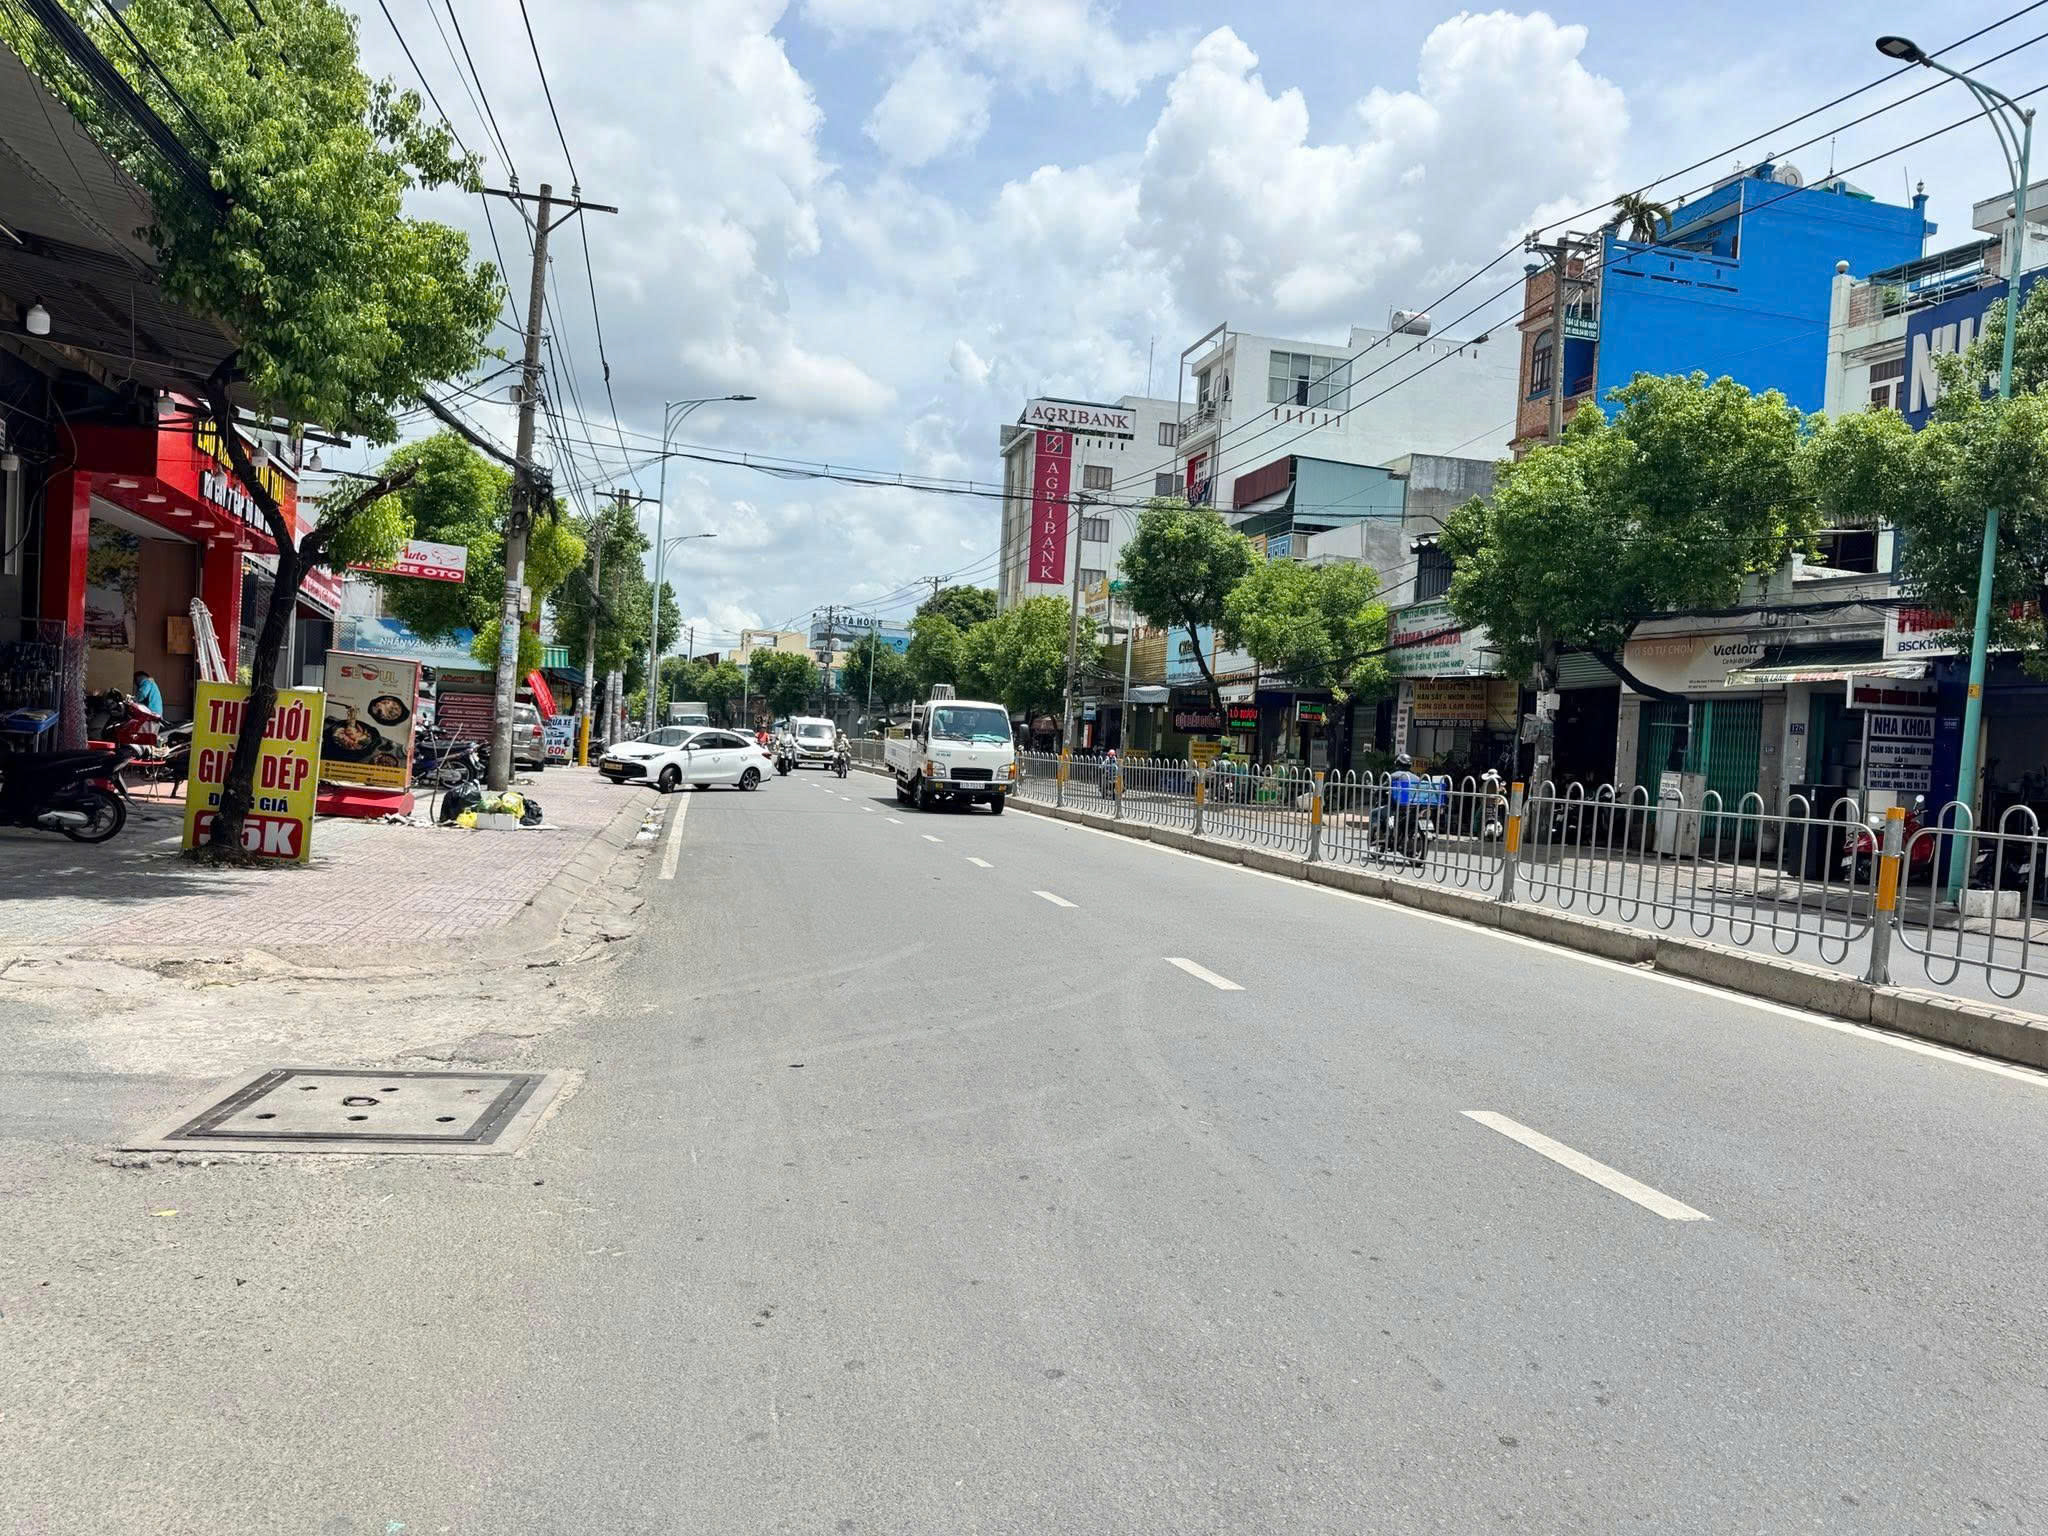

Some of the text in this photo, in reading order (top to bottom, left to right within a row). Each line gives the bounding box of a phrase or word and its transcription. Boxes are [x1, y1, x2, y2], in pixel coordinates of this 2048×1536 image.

[1032, 406, 1129, 429] AGRIBANK
[1040, 462, 1059, 579] AGRIBANK
[423, 566, 462, 581] OTO
[1668, 642, 1694, 657] CHỌN
[1713, 643, 1758, 657] Vietlott
[563, 718, 573, 728] XE
[1873, 716, 1899, 736] NHA
[1901, 718, 1932, 737] KHOA
[261, 751, 308, 791] DÉP
[260, 795, 288, 813] GIÁ
